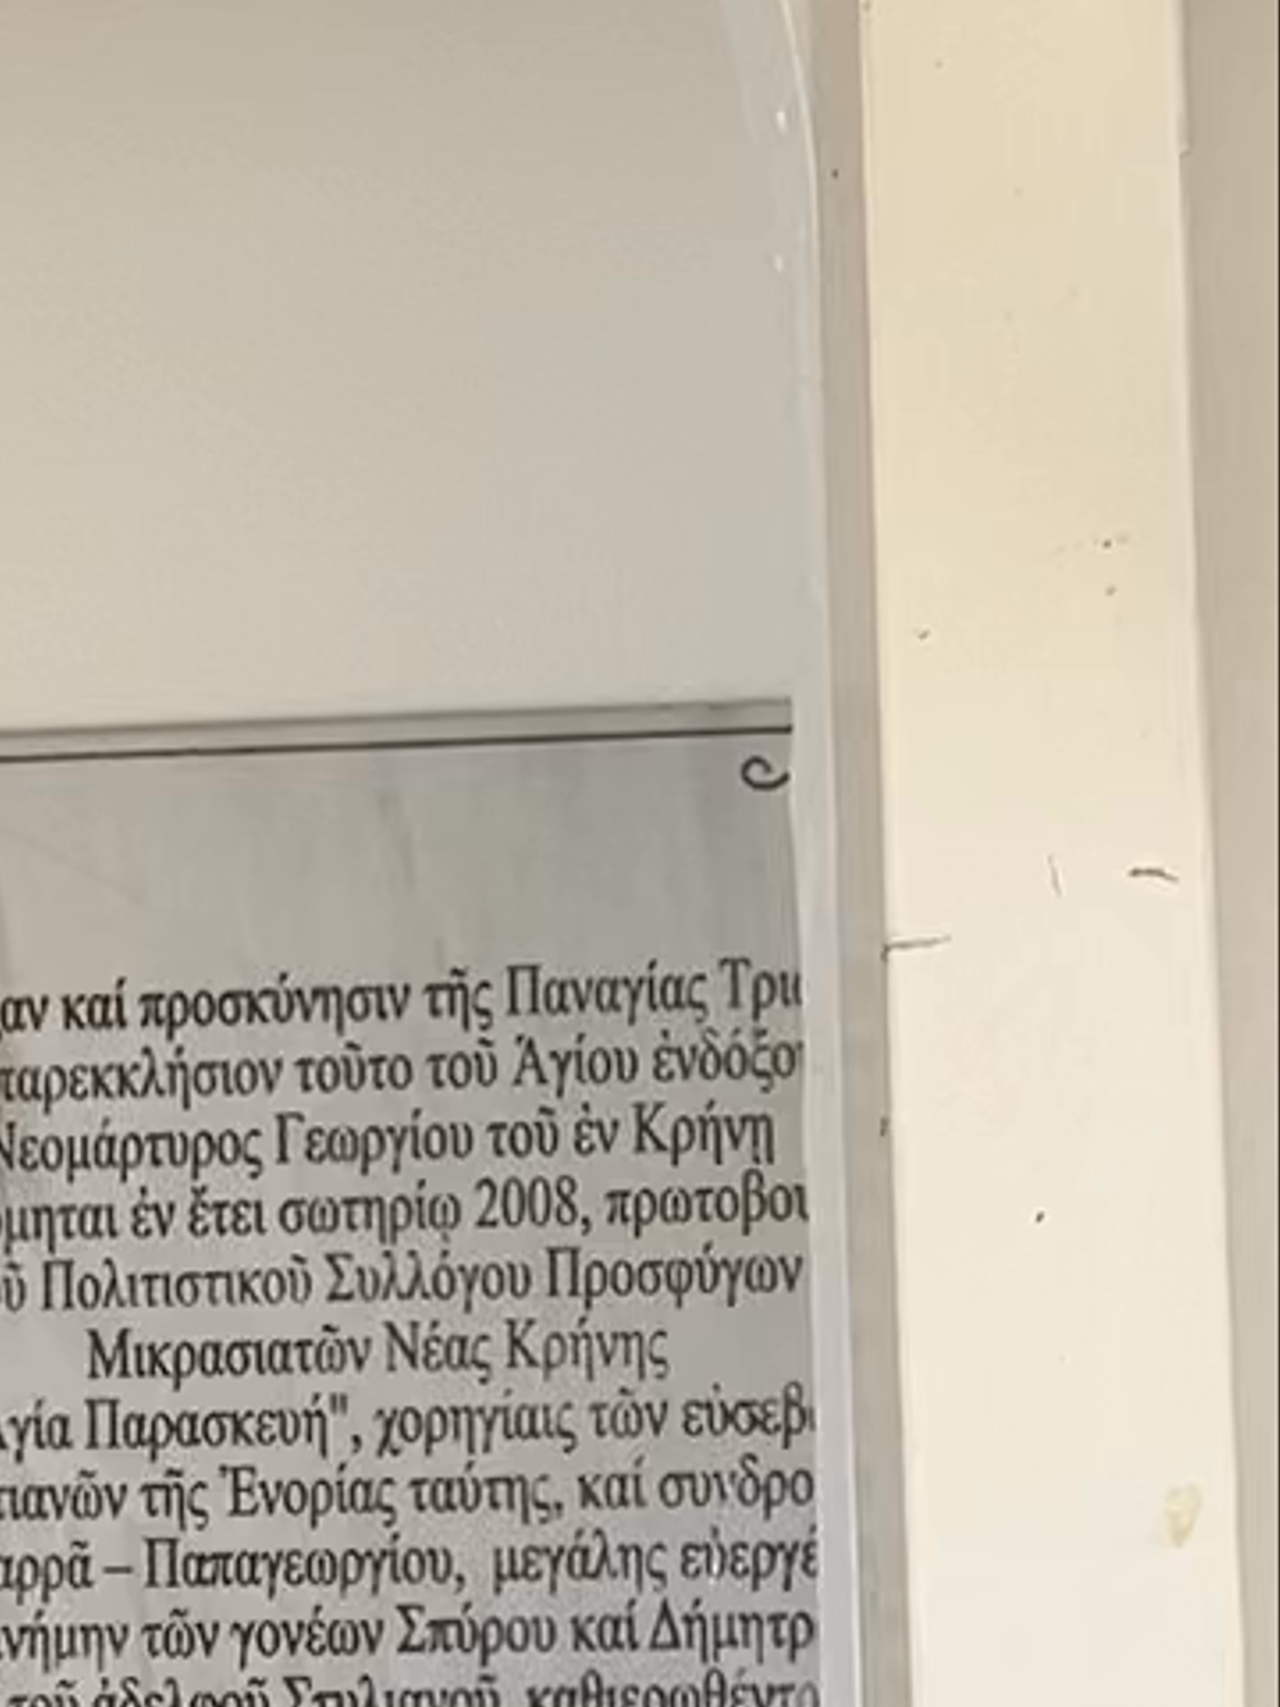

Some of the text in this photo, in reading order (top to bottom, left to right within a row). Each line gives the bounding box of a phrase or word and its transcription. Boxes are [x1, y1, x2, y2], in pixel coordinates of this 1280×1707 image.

[62, 976, 127, 1031] καί
[140, 971, 411, 1041] προσκύνησιν
[506, 958, 708, 1025] Παναγίας
[652, 1026, 806, 1094] ἐνδόξο
[275, 1108, 474, 1177] Γεωργίου
[474, 1174, 593, 1236] 2008,
[324, 1248, 533, 1314] Συλλόγου
[546, 1241, 804, 1311] Προσφύγων
[384, 1319, 491, 1385] Νέας
[504, 1315, 671, 1383] Κρήνης
[84, 1391, 363, 1463] Παρασκευή",
[375, 1387, 579, 1457] χορηγίαις
[408, 1461, 565, 1527] ταύτης,
[576, 1455, 648, 1511] καί
[143, 1529, 467, 1601] Παπαγεωργίου,
[492, 1525, 670, 1595] μεγάλης
[230, 1604, 385, 1671] γονέων
[396, 1599, 557, 1667] Σπύρου
[569, 1598, 639, 1653] καί
